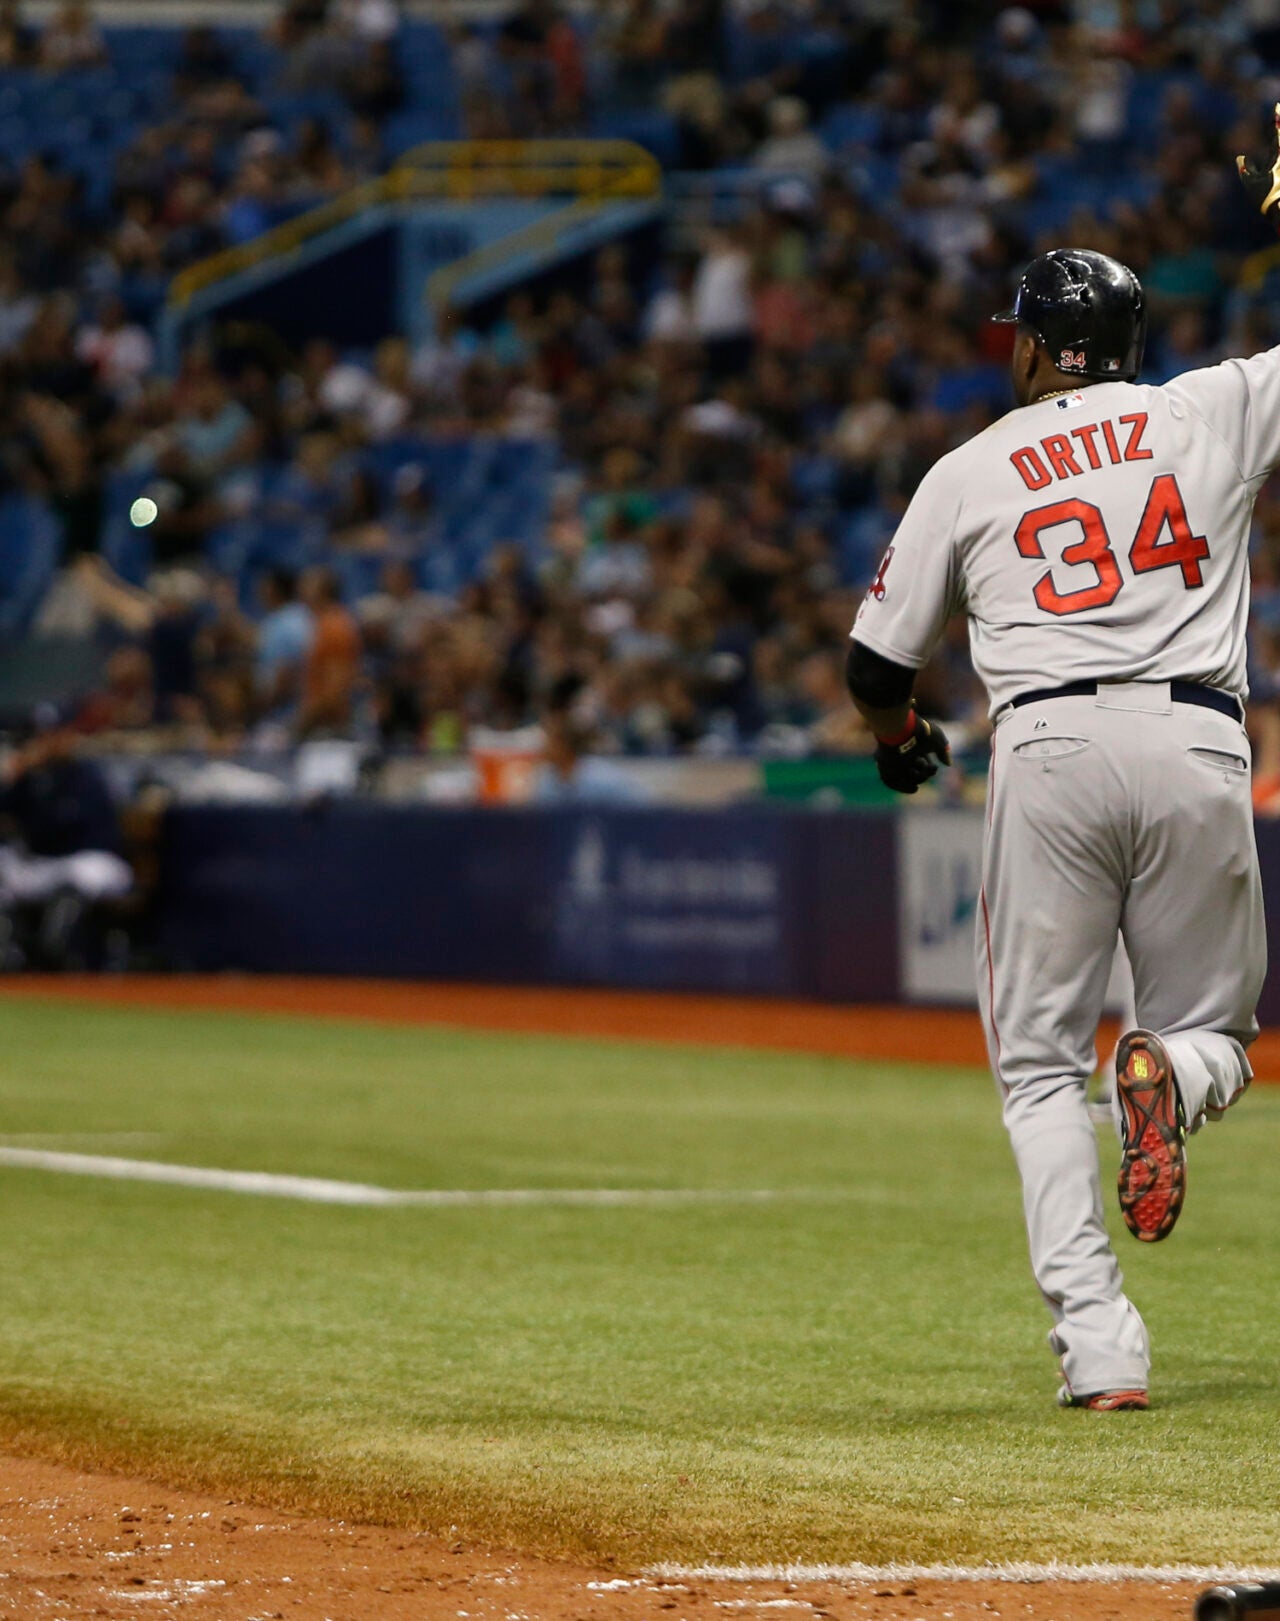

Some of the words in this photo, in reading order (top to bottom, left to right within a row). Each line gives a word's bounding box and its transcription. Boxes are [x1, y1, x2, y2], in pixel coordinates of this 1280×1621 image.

[1060, 349, 1087, 369] 34
[1010, 412, 1154, 492] ORTIZ
[1013, 473, 1211, 617] 34
